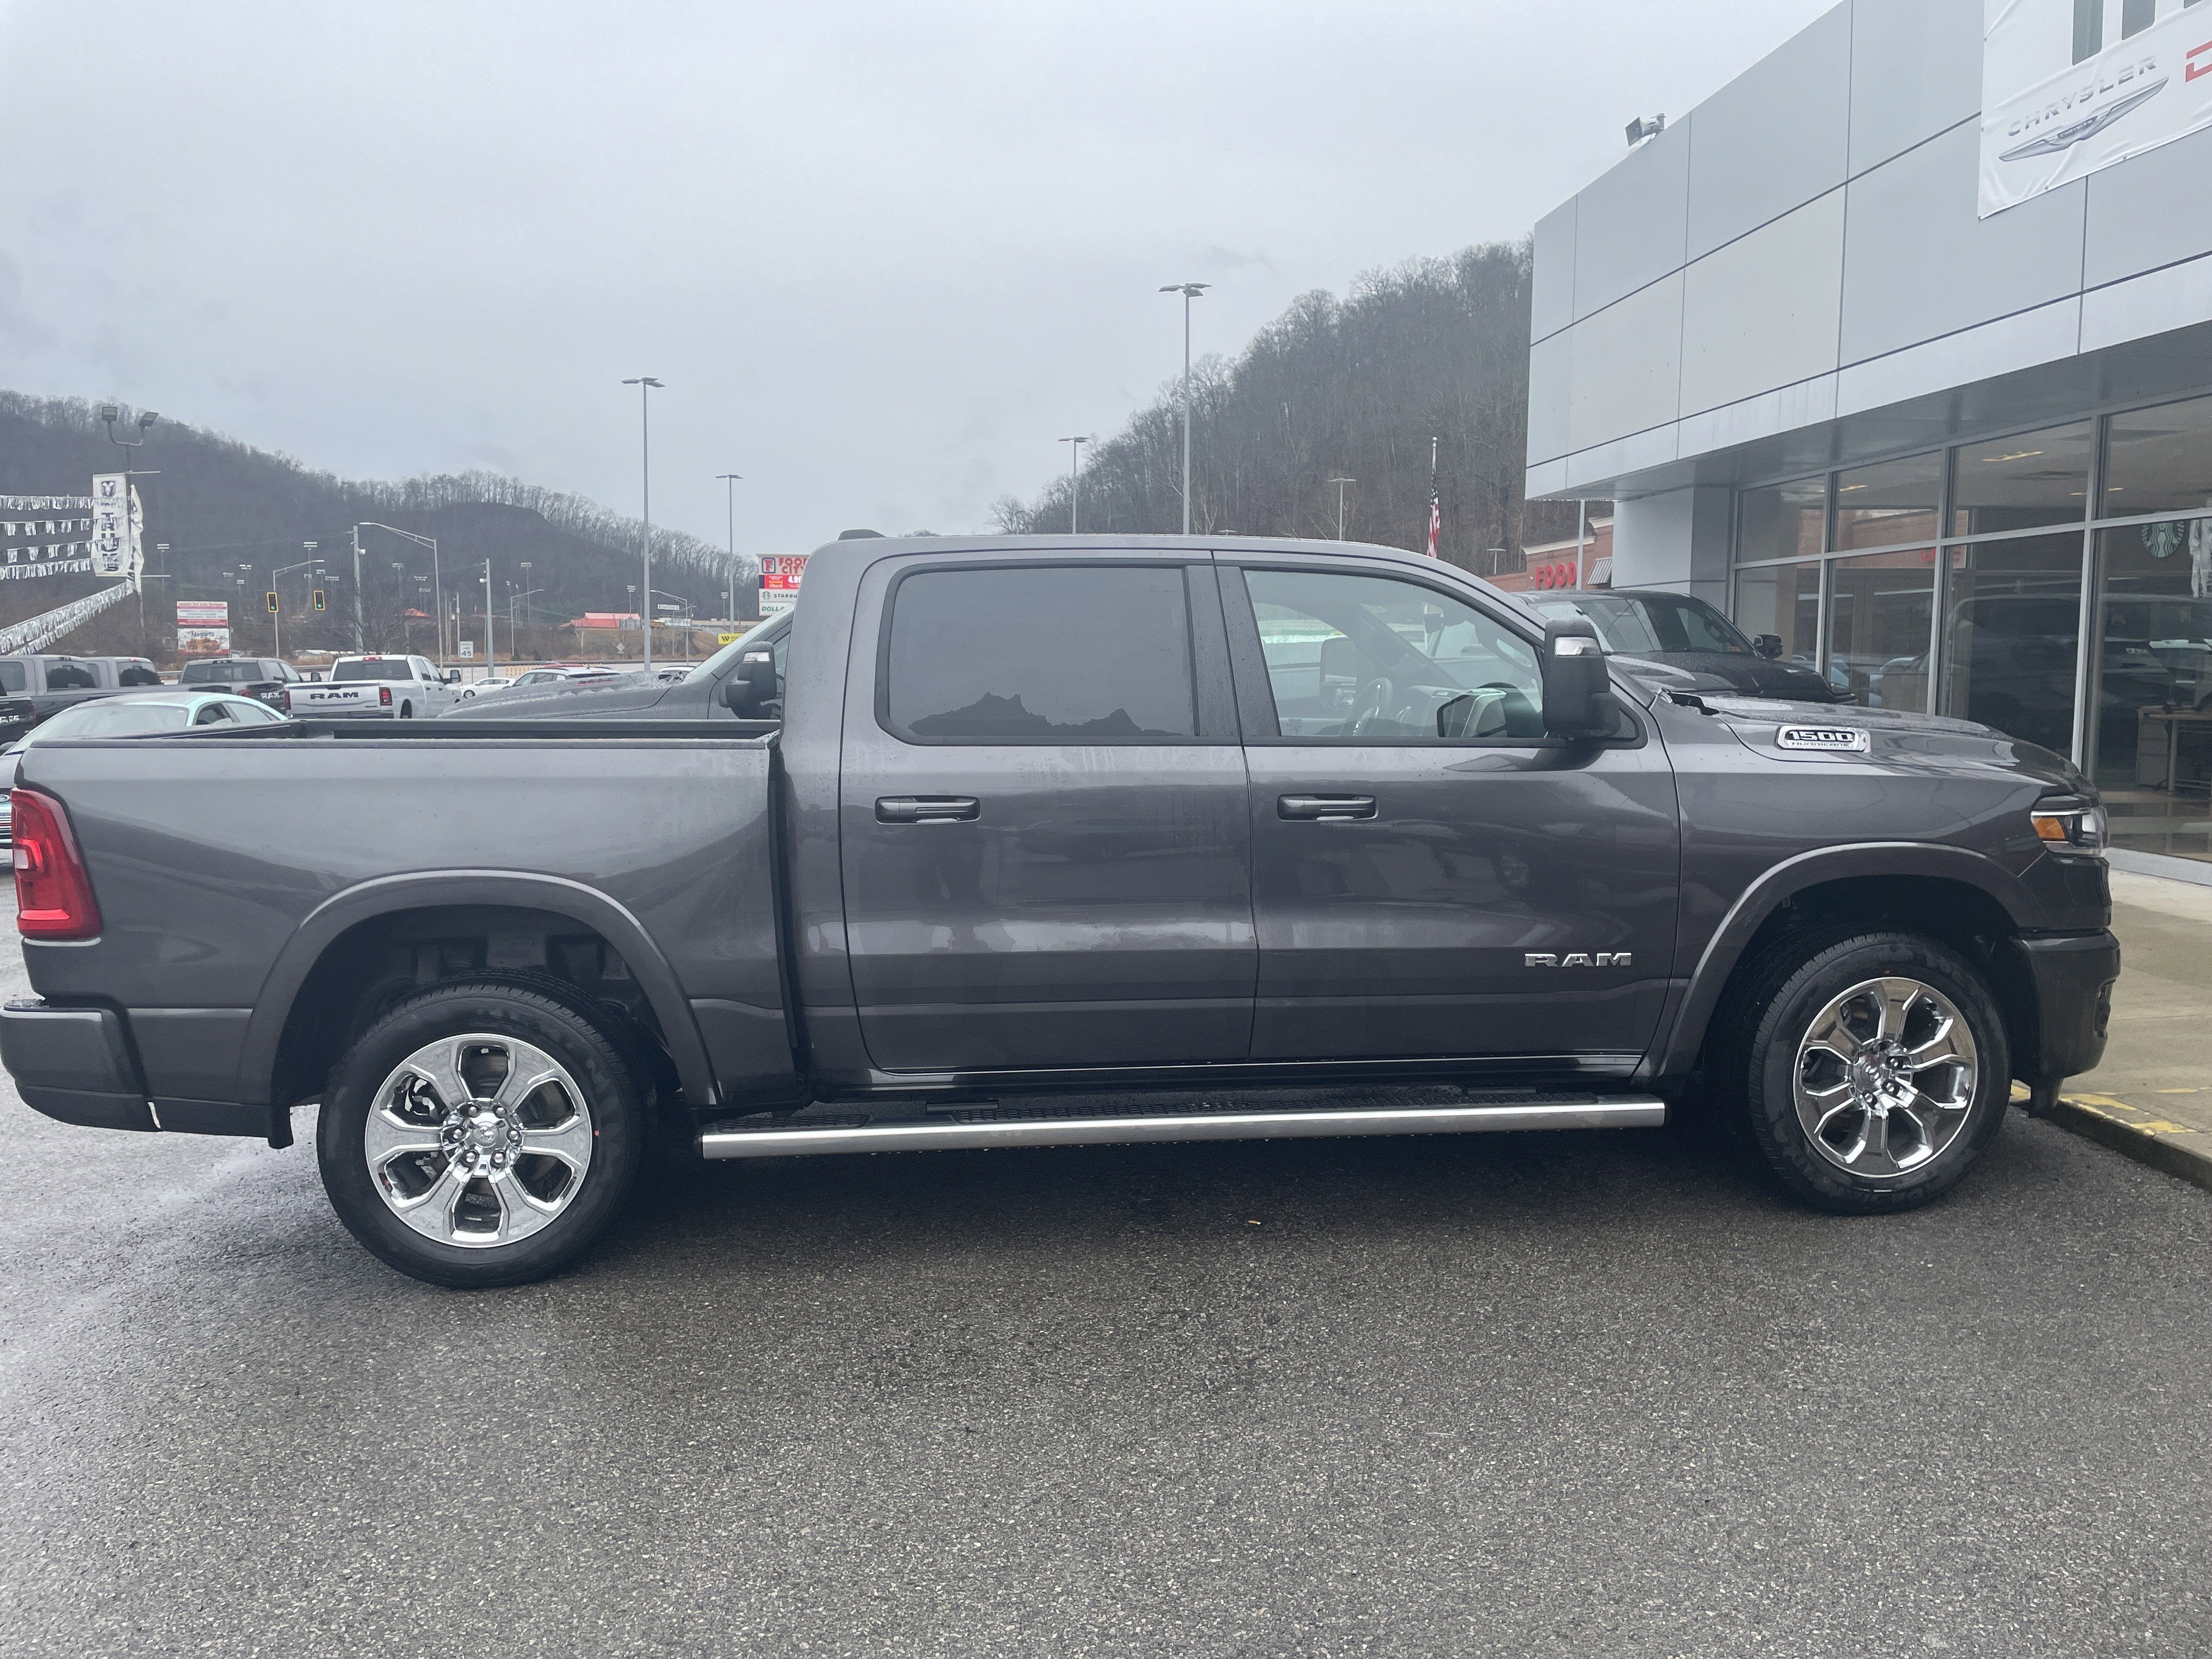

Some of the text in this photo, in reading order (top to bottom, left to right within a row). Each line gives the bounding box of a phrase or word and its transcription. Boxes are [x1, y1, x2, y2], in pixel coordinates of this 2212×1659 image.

[2008, 55, 2157, 137] CHRYSLER
[1536, 562, 1577, 589] FOOD
[1789, 731, 1855, 742] 1500
[1524, 952, 1632, 967] RAM
